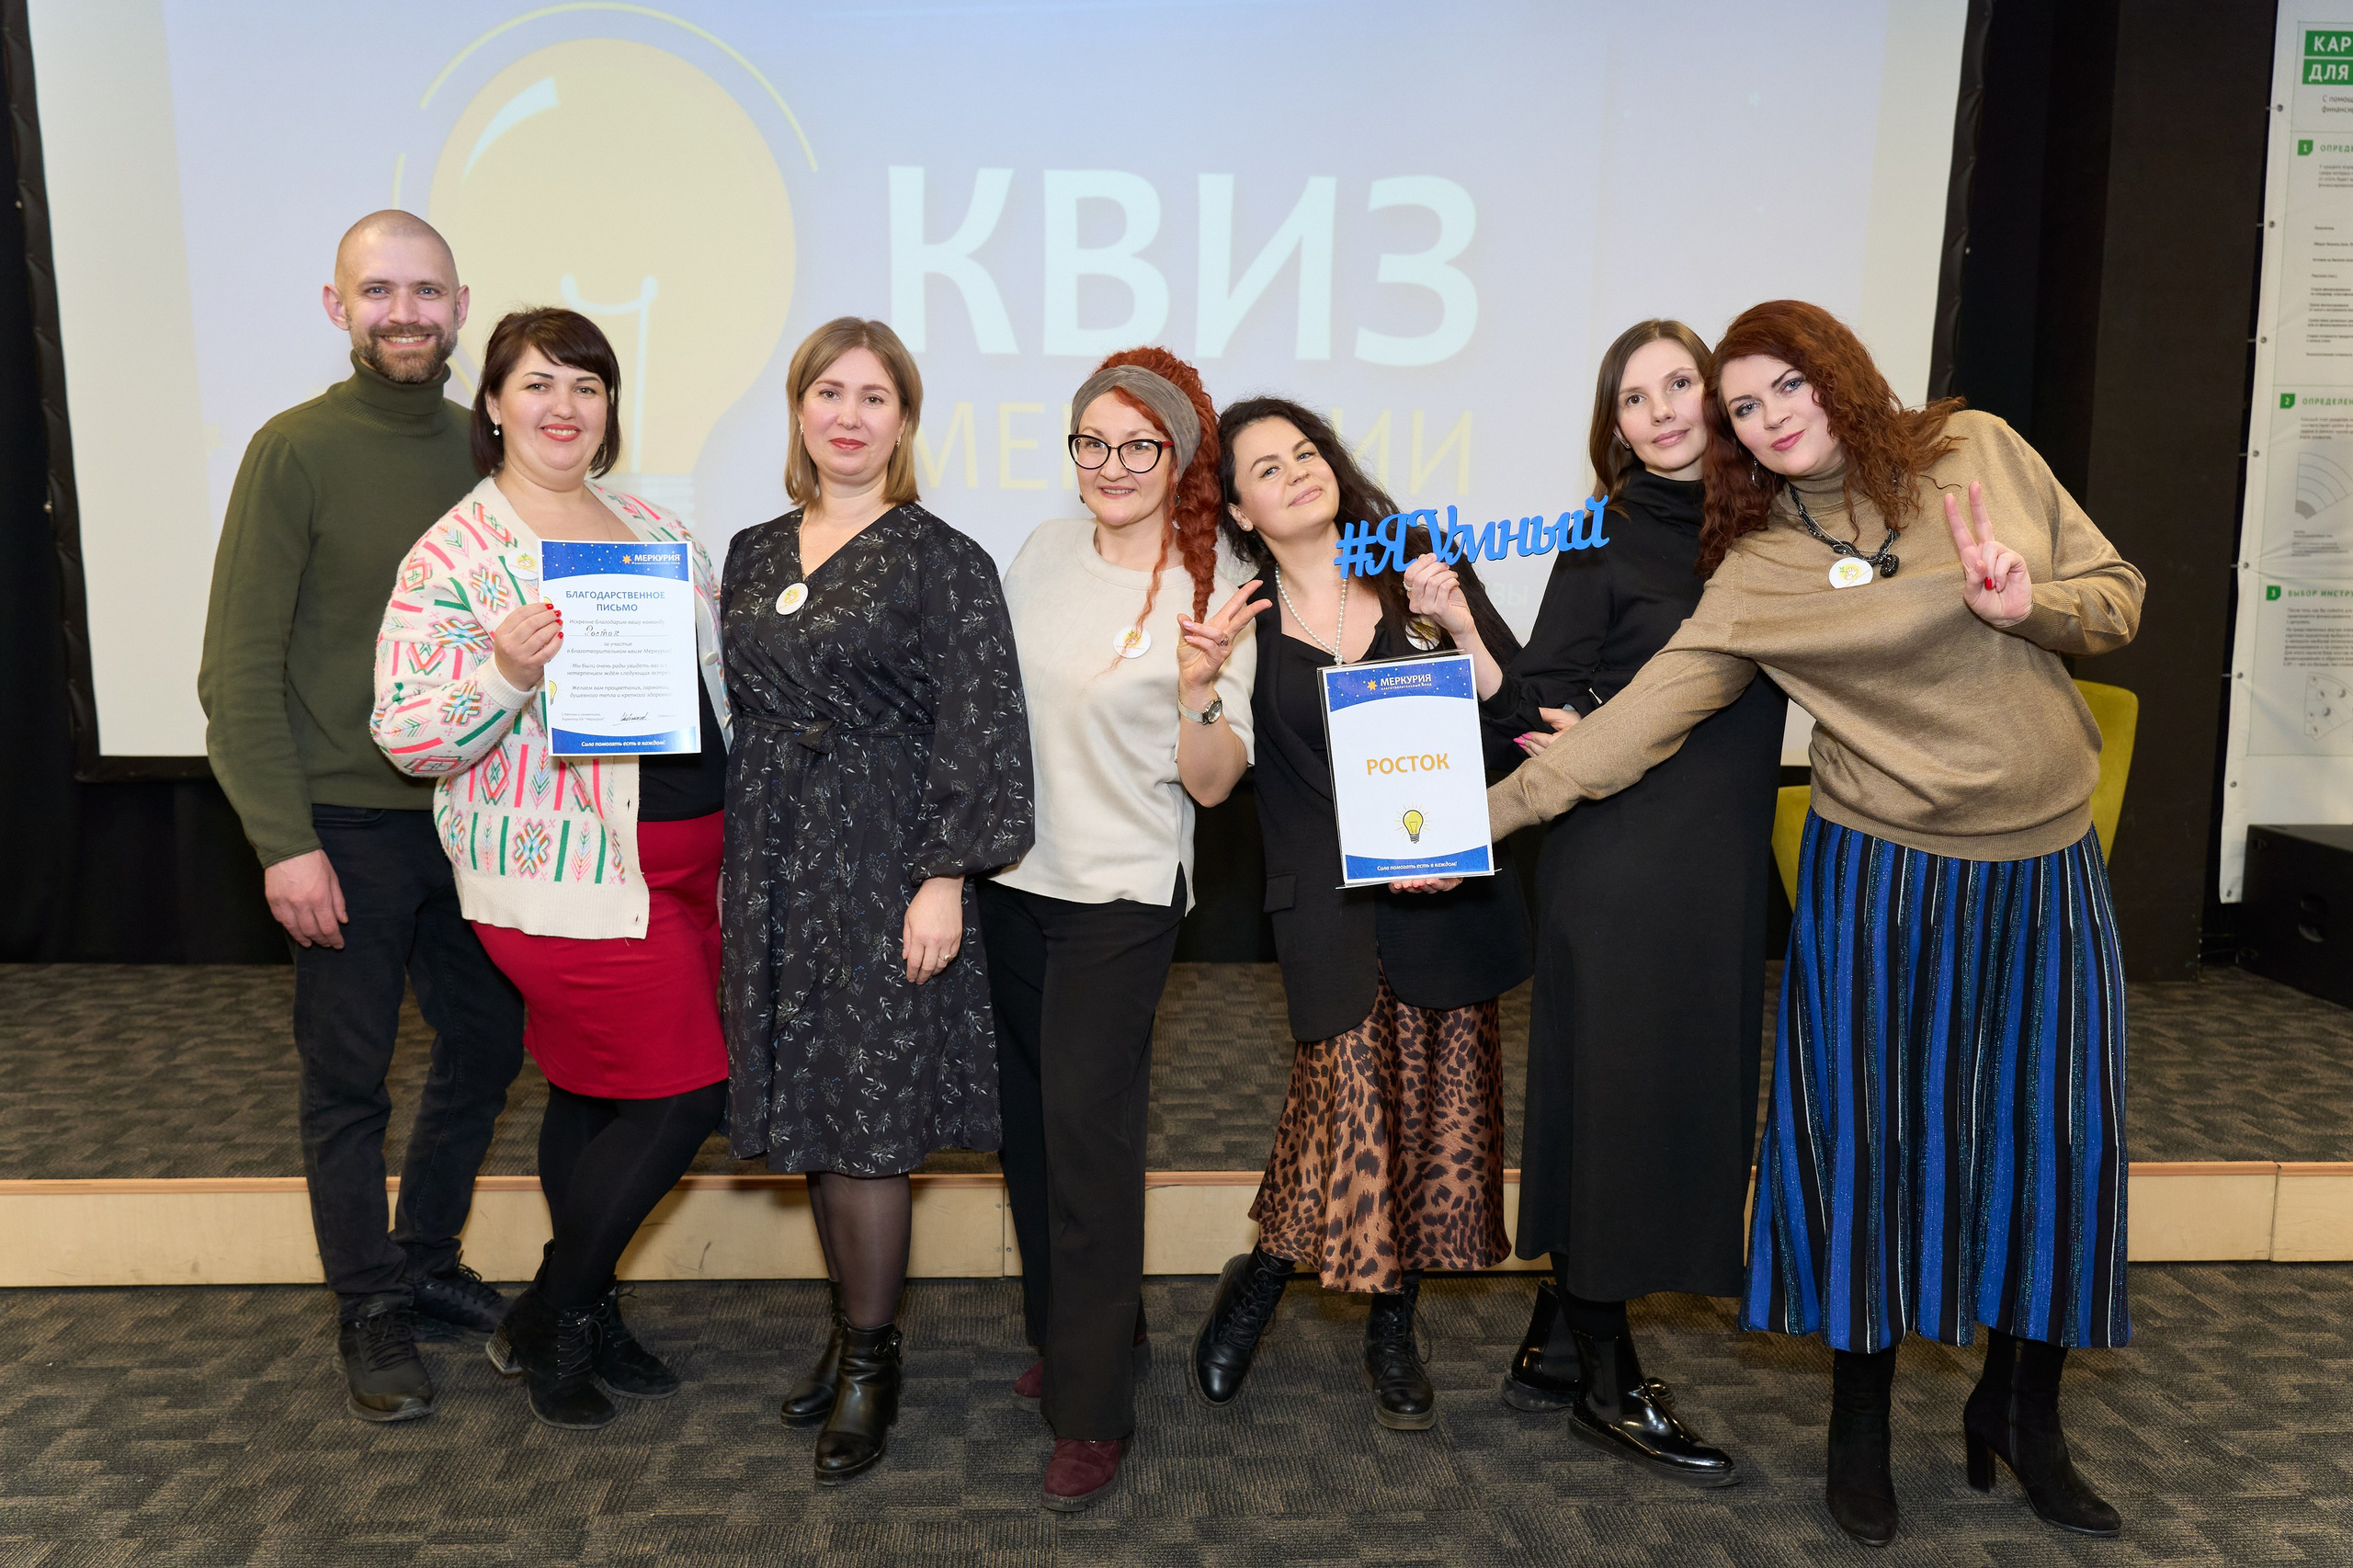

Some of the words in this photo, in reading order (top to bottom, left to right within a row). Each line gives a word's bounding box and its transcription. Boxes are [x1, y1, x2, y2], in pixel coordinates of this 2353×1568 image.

[2313, 36, 2351, 52] КАР
[2308, 63, 2348, 82] ДЛЯ
[888, 165, 1478, 367] КВИЗ
[2284, 396, 2290, 406] 2
[1334, 494, 1610, 579] #ЯУмный
[565, 590, 666, 600] БЛАГОДАРСТВЕННОЕ
[597, 603, 638, 611] ПИСЬМО
[1381, 674, 1431, 687] МЕРКУРИЯ
[1366, 753, 1449, 775] РОСТОК
